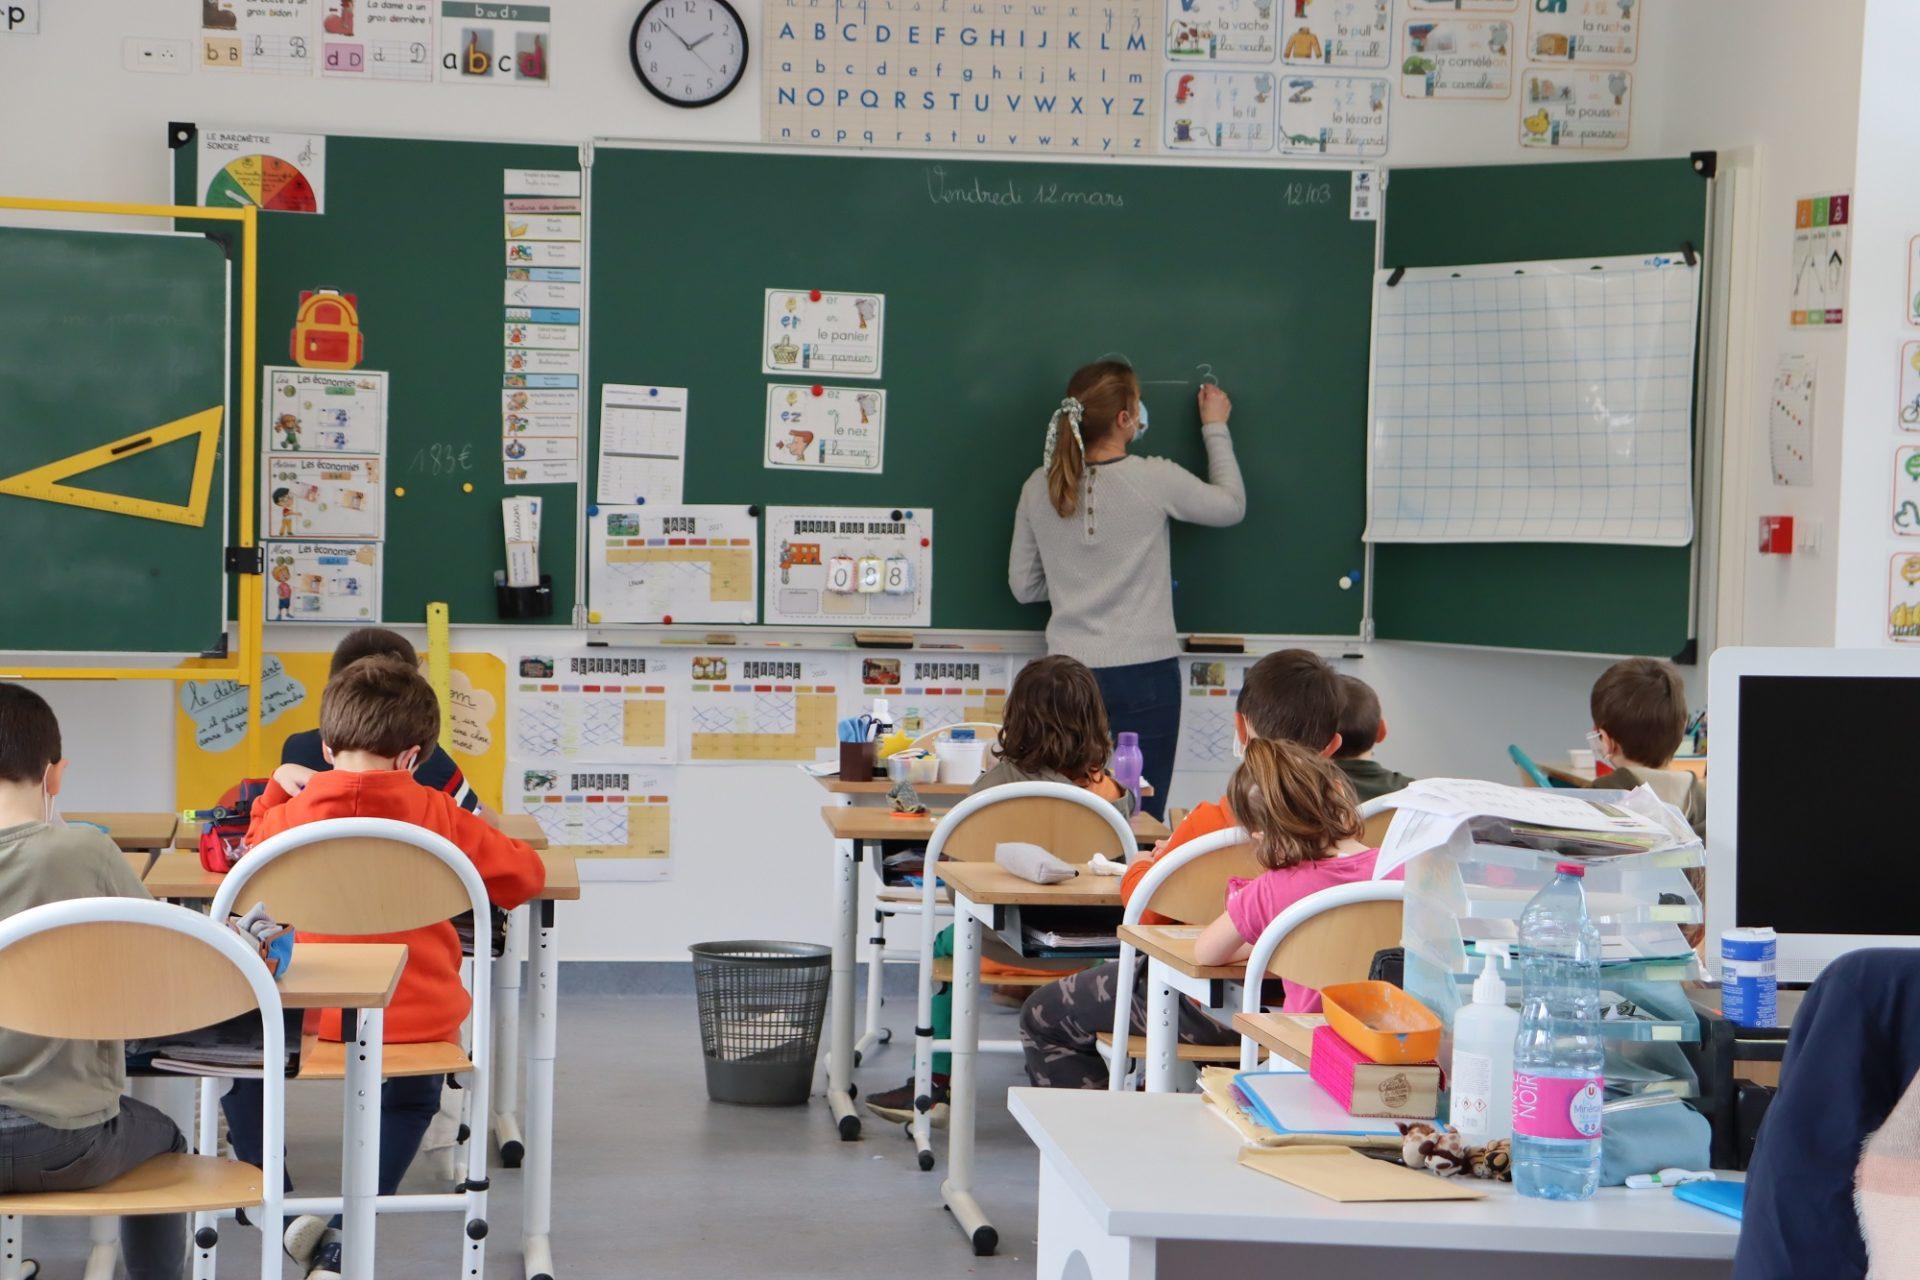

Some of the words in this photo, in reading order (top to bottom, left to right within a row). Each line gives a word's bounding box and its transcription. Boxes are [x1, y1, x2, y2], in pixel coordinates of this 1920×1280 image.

[475, 4, 484, 17] b
[500, 6, 508, 18] d
[666, 6, 674, 18] 11
[684, 1, 696, 13] 12
[708, 8, 713, 21] 1
[8, 6, 25, 30] p
[1218, 17, 1230, 31] la
[1232, 18, 1269, 32] vache
[650, 22, 661, 33] 10
[722, 24, 729, 36] 2
[779, 22, 795, 40] A
[814, 22, 826, 40] B
[843, 23, 858, 42] C
[876, 24, 891, 43] D
[908, 26, 920, 44] E
[935, 26, 946, 45] F
[960, 27, 978, 46] G
[990, 29, 1005, 47] H
[1020, 30, 1024, 48] I
[1038, 31, 1047, 48] J
[1068, 31, 1081, 49] K
[1101, 33, 1110, 50] L
[1127, 33, 1146, 51] M
[207, 43, 218, 60] b
[230, 47, 238, 61] B
[644, 41, 652, 51] 9
[730, 44, 734, 55] 3
[327, 50, 338, 66] d
[350, 52, 361, 66] D
[443, 53, 458, 70] a
[498, 56, 512, 72] c
[650, 62, 658, 73] 8
[720, 64, 726, 75] 4
[781, 61, 791, 72] a
[815, 59, 826, 73] b
[845, 64, 854, 74] c
[877, 61, 887, 76] d
[908, 67, 918, 77] e
[936, 62, 943, 77] f
[963, 68, 973, 82] g
[992, 65, 1001, 79] h
[1019, 66, 1023, 80] i
[1040, 66, 1045, 84] j
[1068, 67, 1076, 82] k
[1102, 68, 1106, 83] l
[1129, 72, 1142, 83] m
[666, 76, 672, 88] 7
[706, 78, 713, 89] 5
[685, 86, 692, 95] 6
[778, 87, 795, 105] N
[806, 87, 825, 107] O
[837, 89, 849, 107] P
[860, 89, 879, 108] Q
[894, 91, 906, 109] R
[922, 91, 935, 110] S
[949, 92, 961, 110] T
[975, 94, 989, 112] U
[1007, 94, 1021, 112] V
[1034, 95, 1056, 113] W
[1070, 96, 1083, 114] X
[1101, 97, 1115, 115] Y
[1132, 98, 1145, 116] Z
[782, 128, 791, 138] n
[811, 128, 821, 138] o
[837, 130, 847, 143] p
[863, 130, 873, 144] q
[896, 131, 902, 141] r
[925, 132, 932, 142] s
[951, 130, 957, 143] t
[977, 134, 986, 144] u
[1009, 135, 1017, 145] v
[1039, 135, 1051, 145] w
[1071, 136, 1079, 146] x
[1102, 137, 1111, 150] y
[1134, 138, 1141, 148] z
[925, 165, 1021, 206] Vendredi
[1034, 184, 1058, 204] 12
[1062, 190, 1124, 207] mars
[1283, 182, 1331, 206] 12/03
[818, 328, 828, 340] le
[831, 329, 869, 342] panier
[812, 344, 824, 360] le
[832, 353, 872, 370] panier
[848, 425, 867, 436] nez
[835, 568, 847, 587] 0
[890, 567, 901, 586] 8
[571, 658, 646, 675] SEPTEMBRE
[744, 662, 800, 679] OCTOBRE
[915, 663, 980, 680] NOVEMBRE
[1519, 1074, 1538, 1118] NOIR
[1588, 1087, 1595, 1096] U
